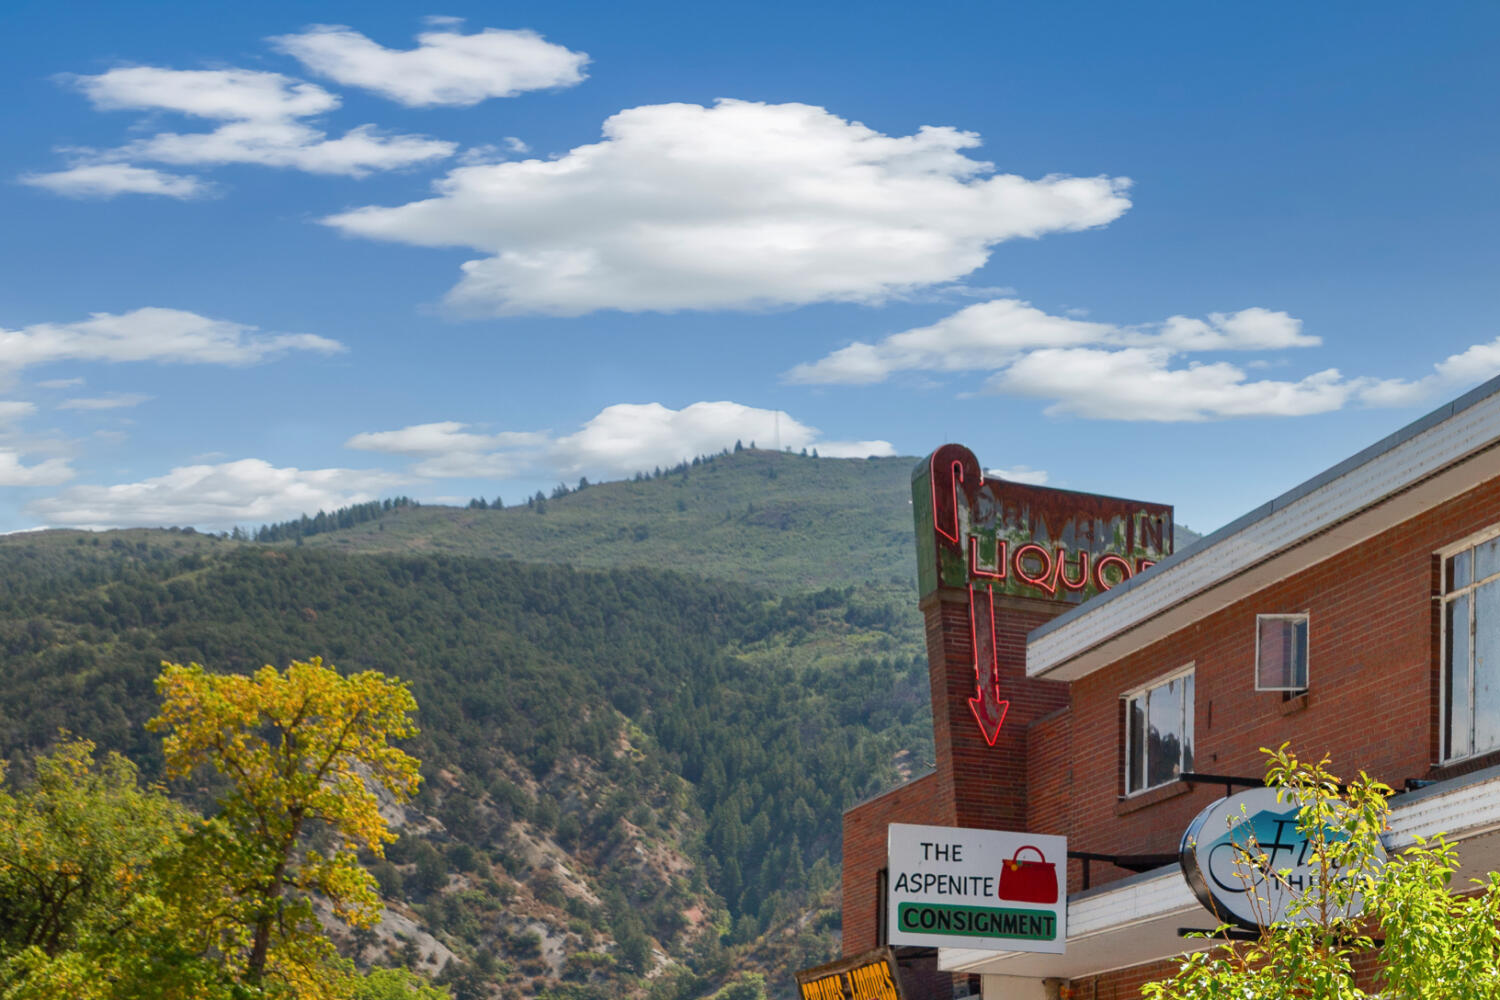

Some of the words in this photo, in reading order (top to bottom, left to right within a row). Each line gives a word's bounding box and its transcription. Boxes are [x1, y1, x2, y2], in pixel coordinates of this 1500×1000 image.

[968, 533, 1157, 594] LIQUO
[920, 842, 963, 863] THE
[895, 873, 994, 897] ASPENITE
[903, 907, 1055, 938] CONSIGNMENT
